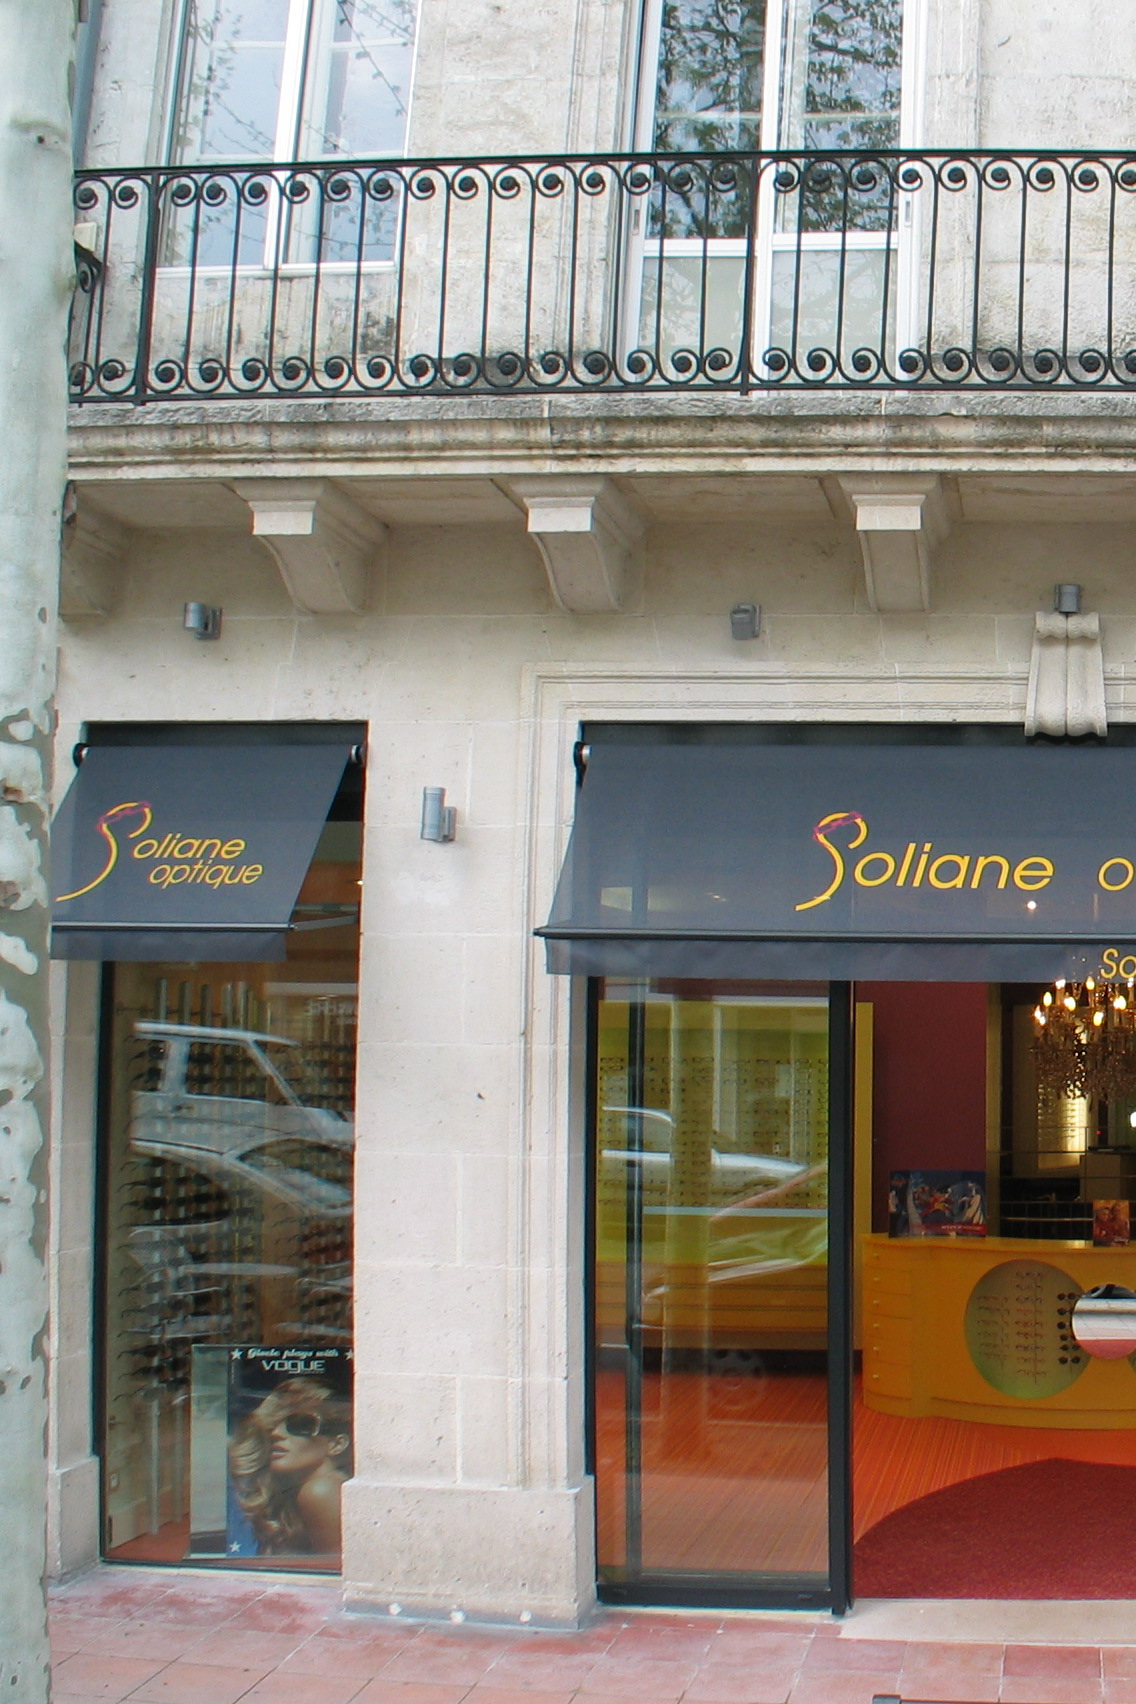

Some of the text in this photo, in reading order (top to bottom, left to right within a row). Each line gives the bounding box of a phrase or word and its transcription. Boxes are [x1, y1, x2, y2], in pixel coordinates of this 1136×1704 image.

[56, 801, 247, 902] Soliane
[149, 860, 263, 890] optique
[793, 811, 1054, 911] Soliane
[261, 1360, 326, 1374] VOGUE
